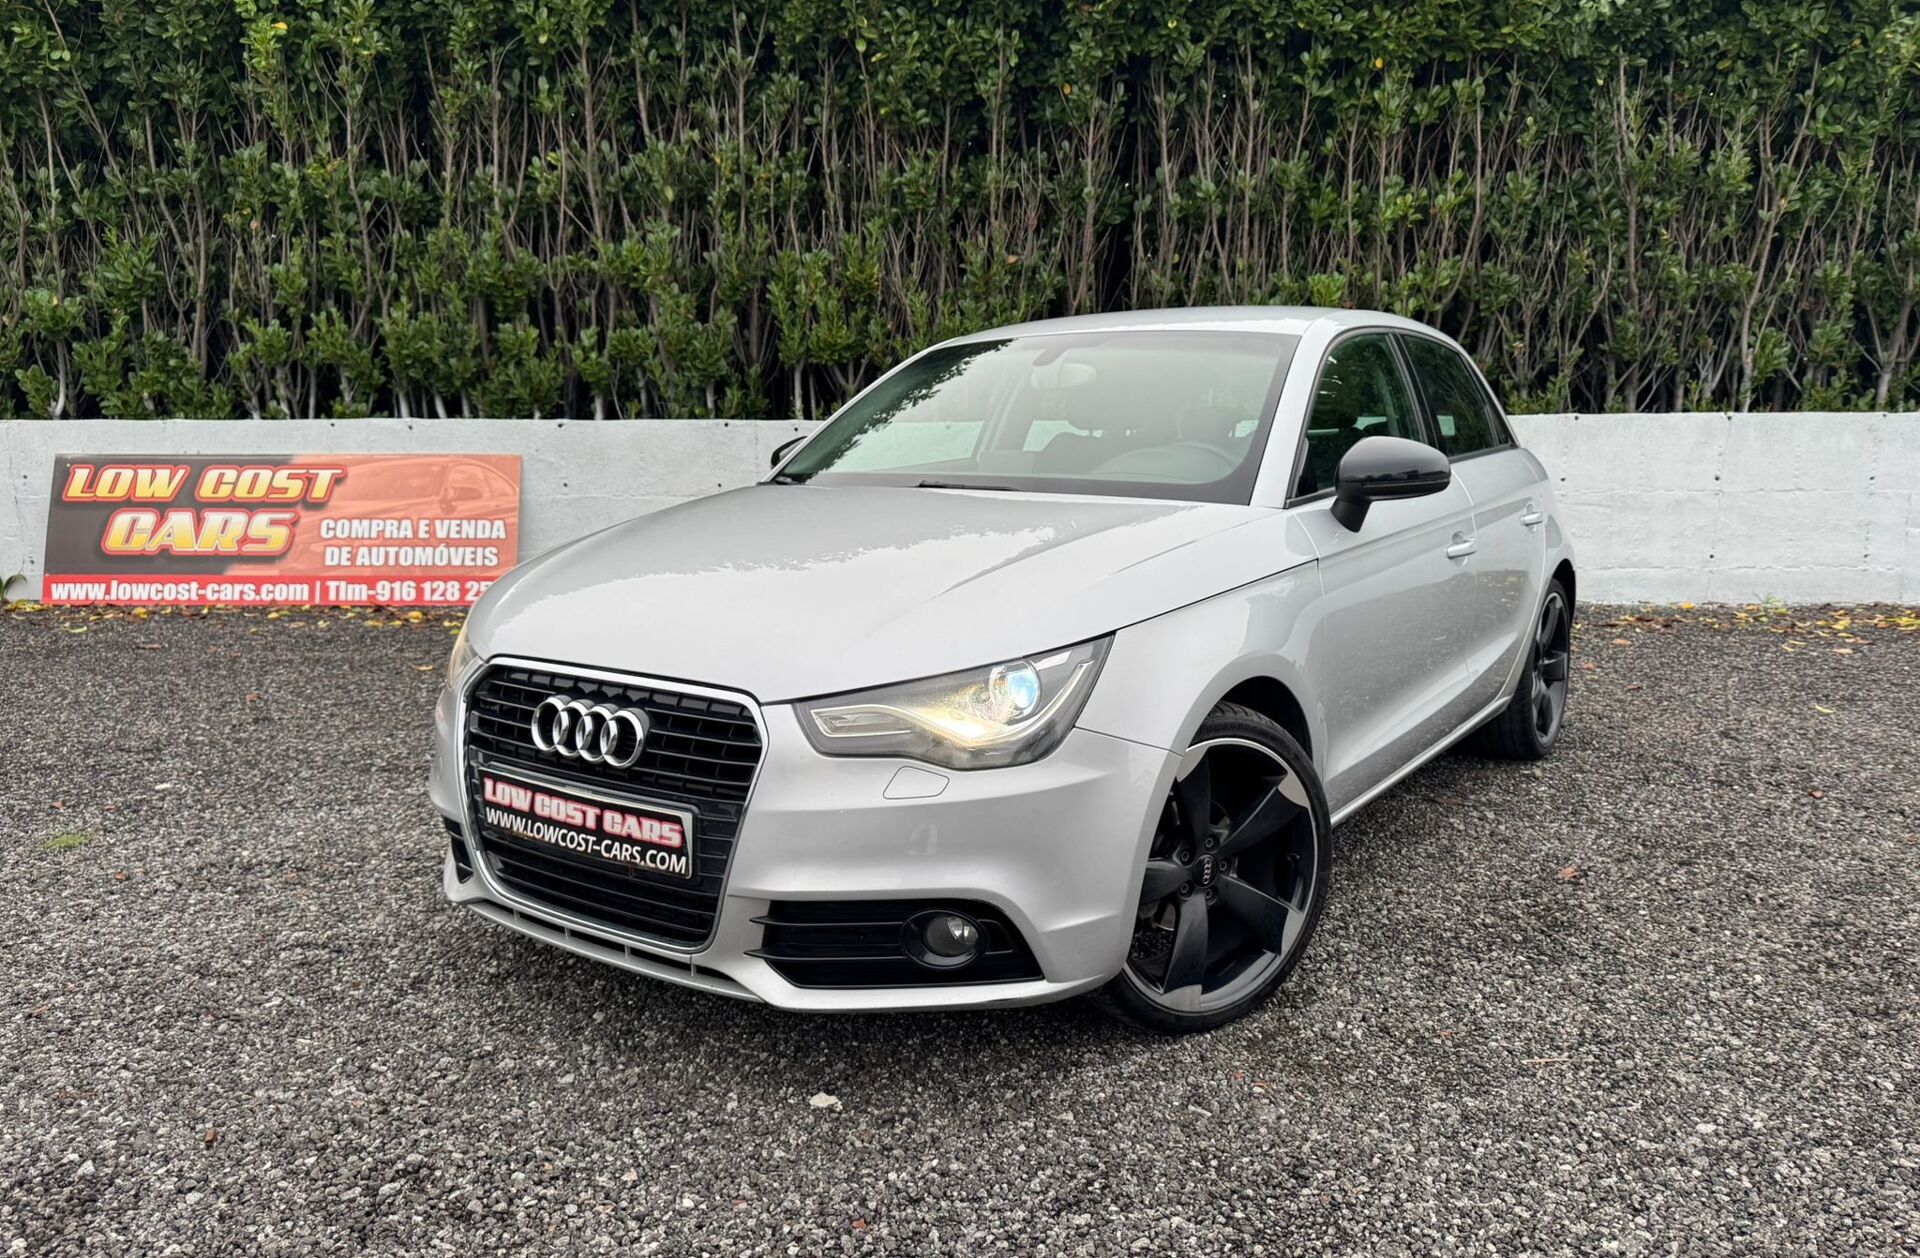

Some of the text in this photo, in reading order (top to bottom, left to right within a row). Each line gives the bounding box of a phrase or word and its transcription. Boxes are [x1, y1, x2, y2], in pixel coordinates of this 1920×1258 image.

[64, 465, 348, 501] LOW COST
[102, 508, 297, 554] CARS
[320, 519, 506, 539] COMPRA E VENDA
[324, 543, 498, 567] DE AUTOMÓVEIS
[50, 579, 309, 602] www.lowcost-cars.com
[326, 580, 416, 602] Tlm-916
[421, 580, 460, 602] 128
[484, 777, 685, 848] LOW COST CARS
[486, 806, 687, 875] WWW.LOWCOST-CARS.COM
